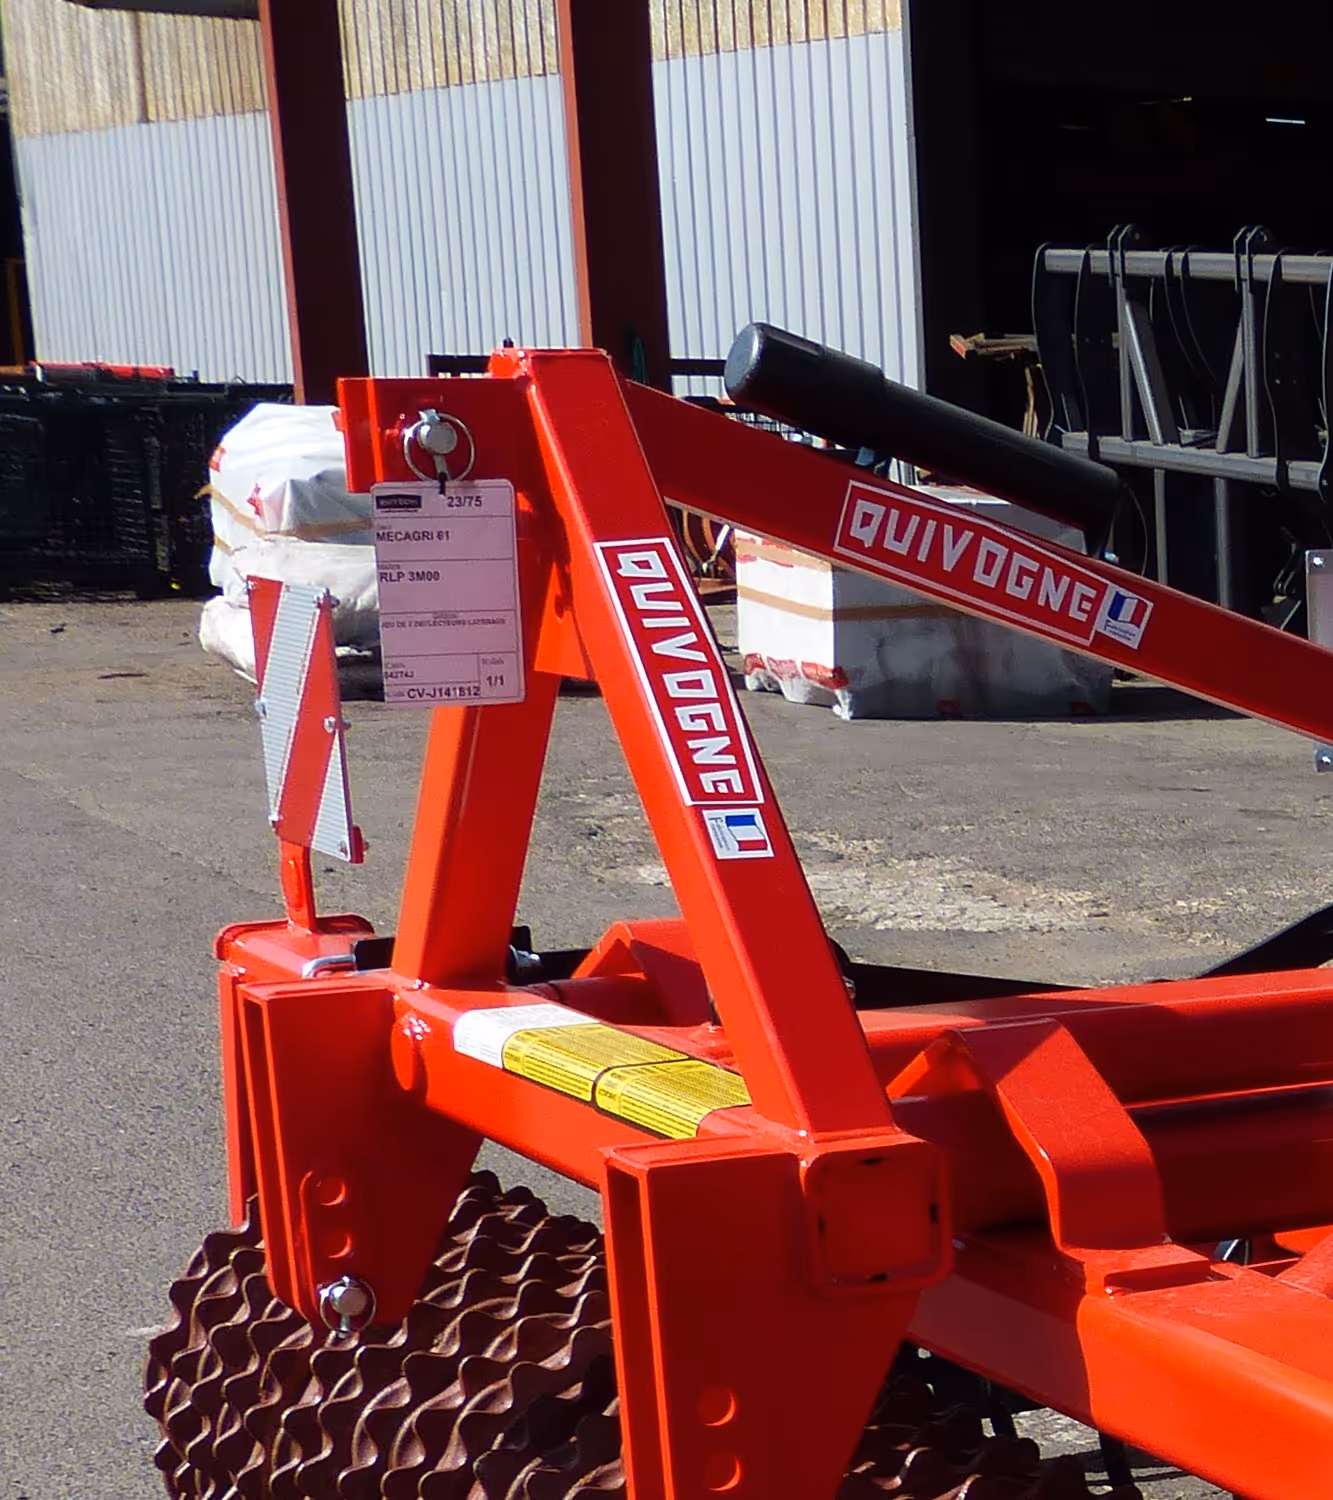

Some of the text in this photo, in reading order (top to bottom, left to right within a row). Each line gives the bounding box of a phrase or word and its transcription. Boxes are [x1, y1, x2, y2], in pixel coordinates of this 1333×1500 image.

[447, 495, 482, 508] 23/75
[376, 530, 434, 542] MECAGRI
[849, 499, 1097, 622] QUIVOGNE
[380, 570, 440, 582] RLP 3M00
[617, 550, 744, 794] QUIVOGNE
[486, 674, 504, 687] 1/1
